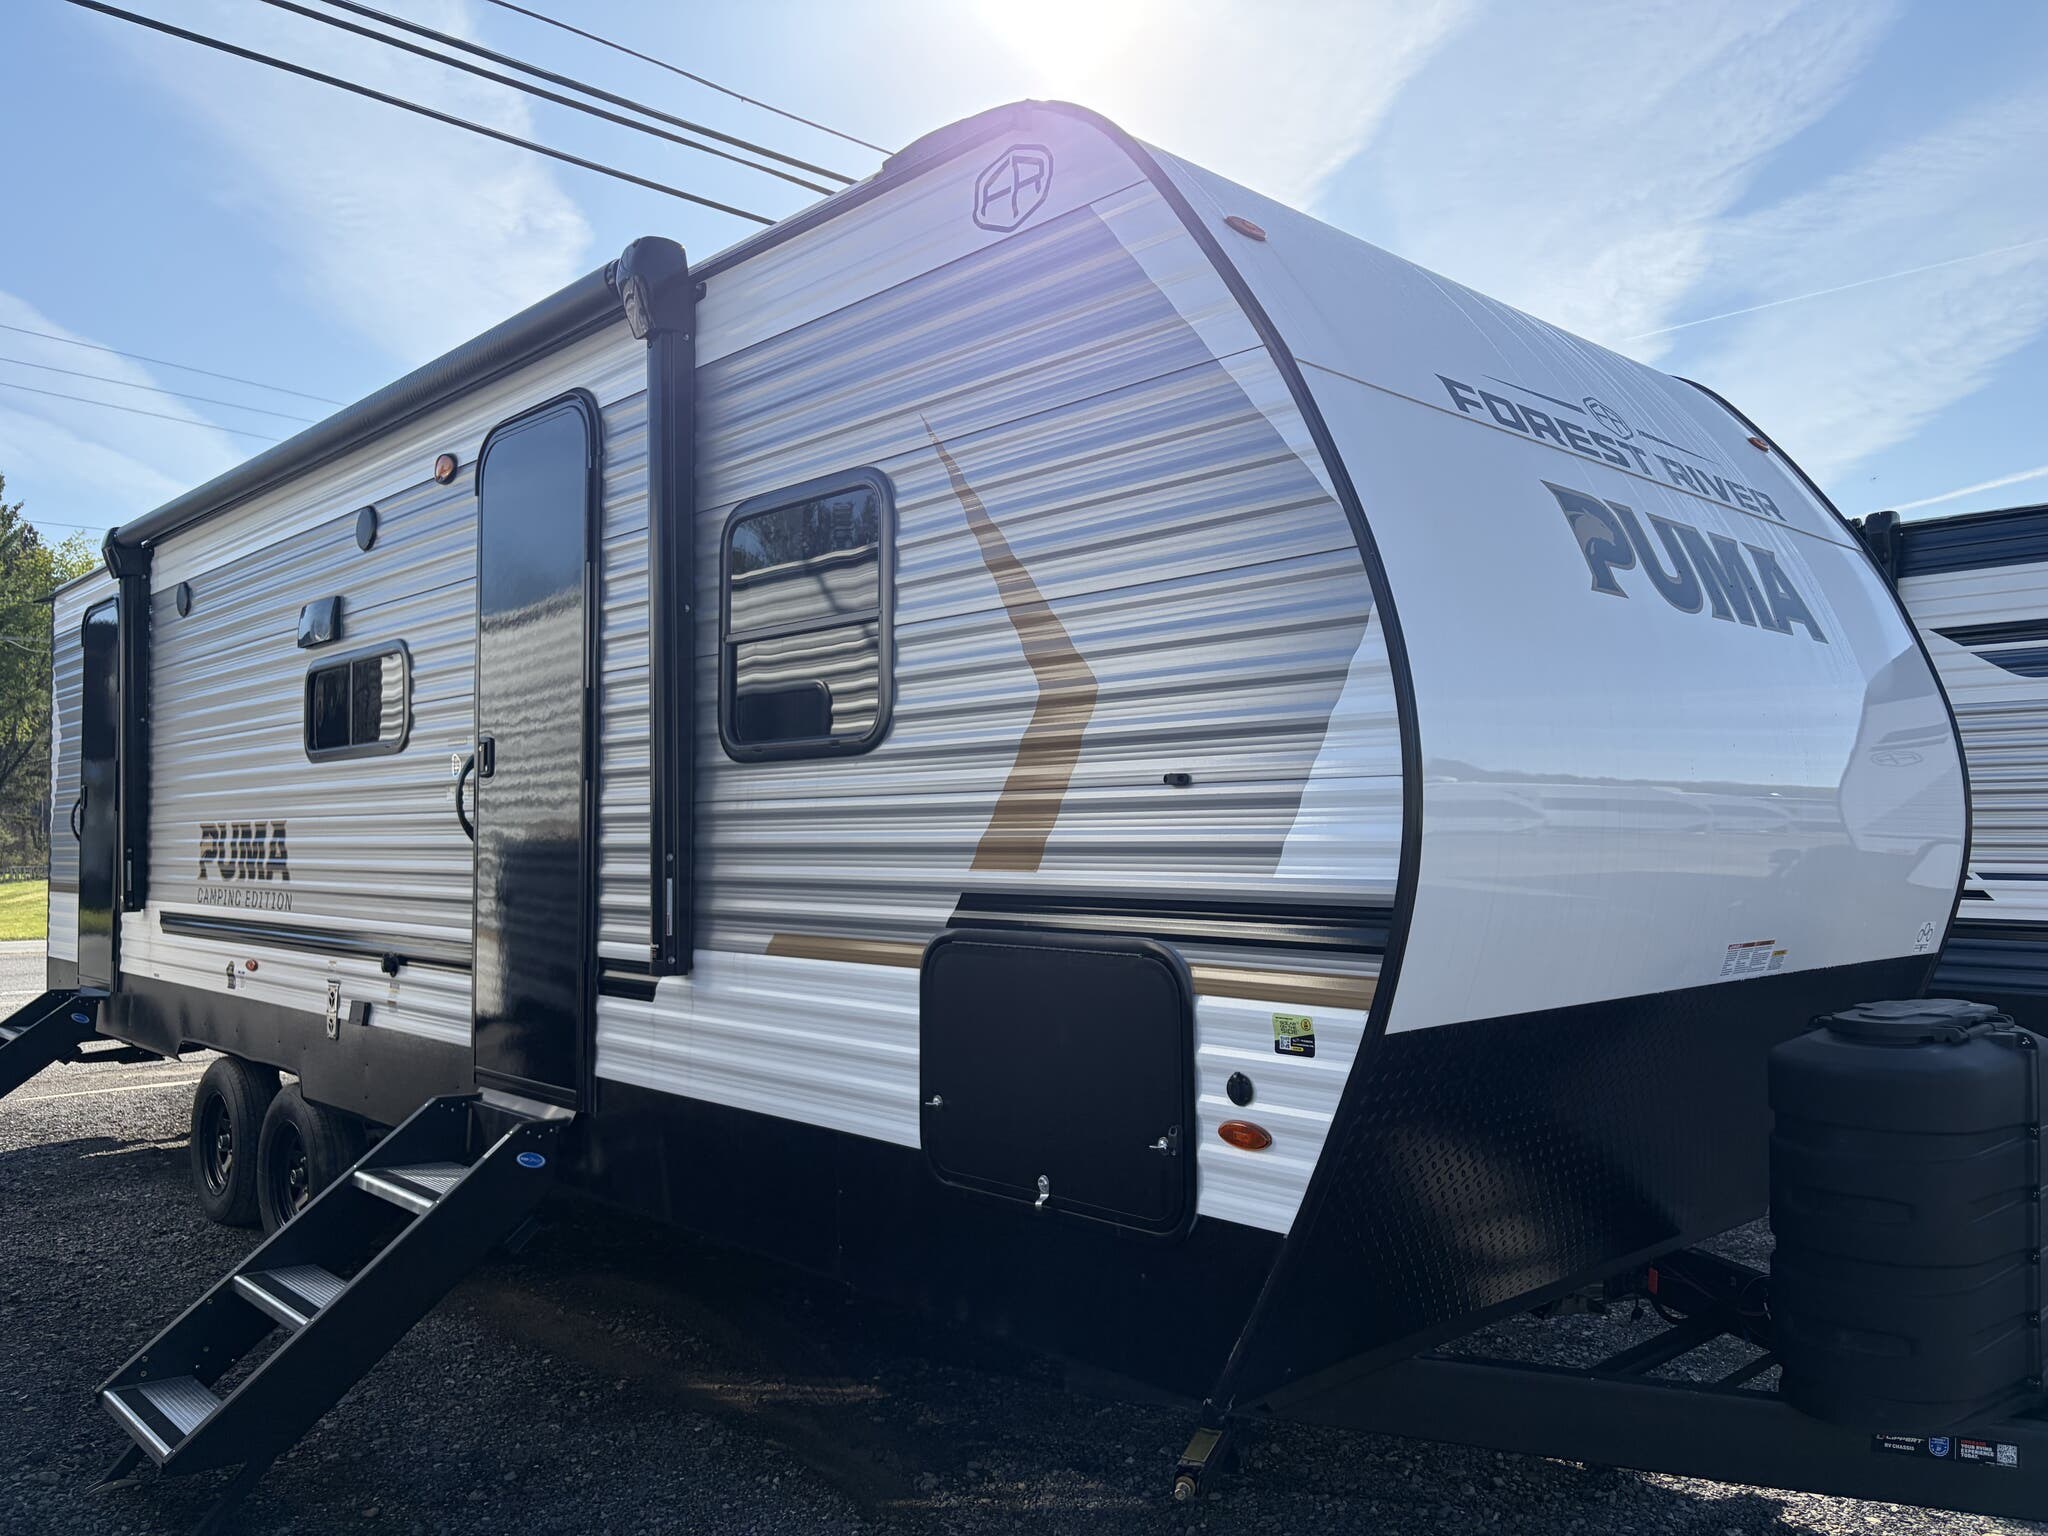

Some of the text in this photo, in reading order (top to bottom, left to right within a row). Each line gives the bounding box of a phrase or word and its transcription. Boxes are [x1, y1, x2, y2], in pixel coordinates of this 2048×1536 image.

[1434, 373, 1787, 522] FOREST RIVER
[1540, 479, 1829, 644] PUMA
[197, 820, 291, 881] PUMA
[197, 887, 293, 911] CAMPING EDITION
[1892, 1443, 1915, 1451] CHASSIS
[1960, 1448, 1995, 1457] EXPERIENCE
